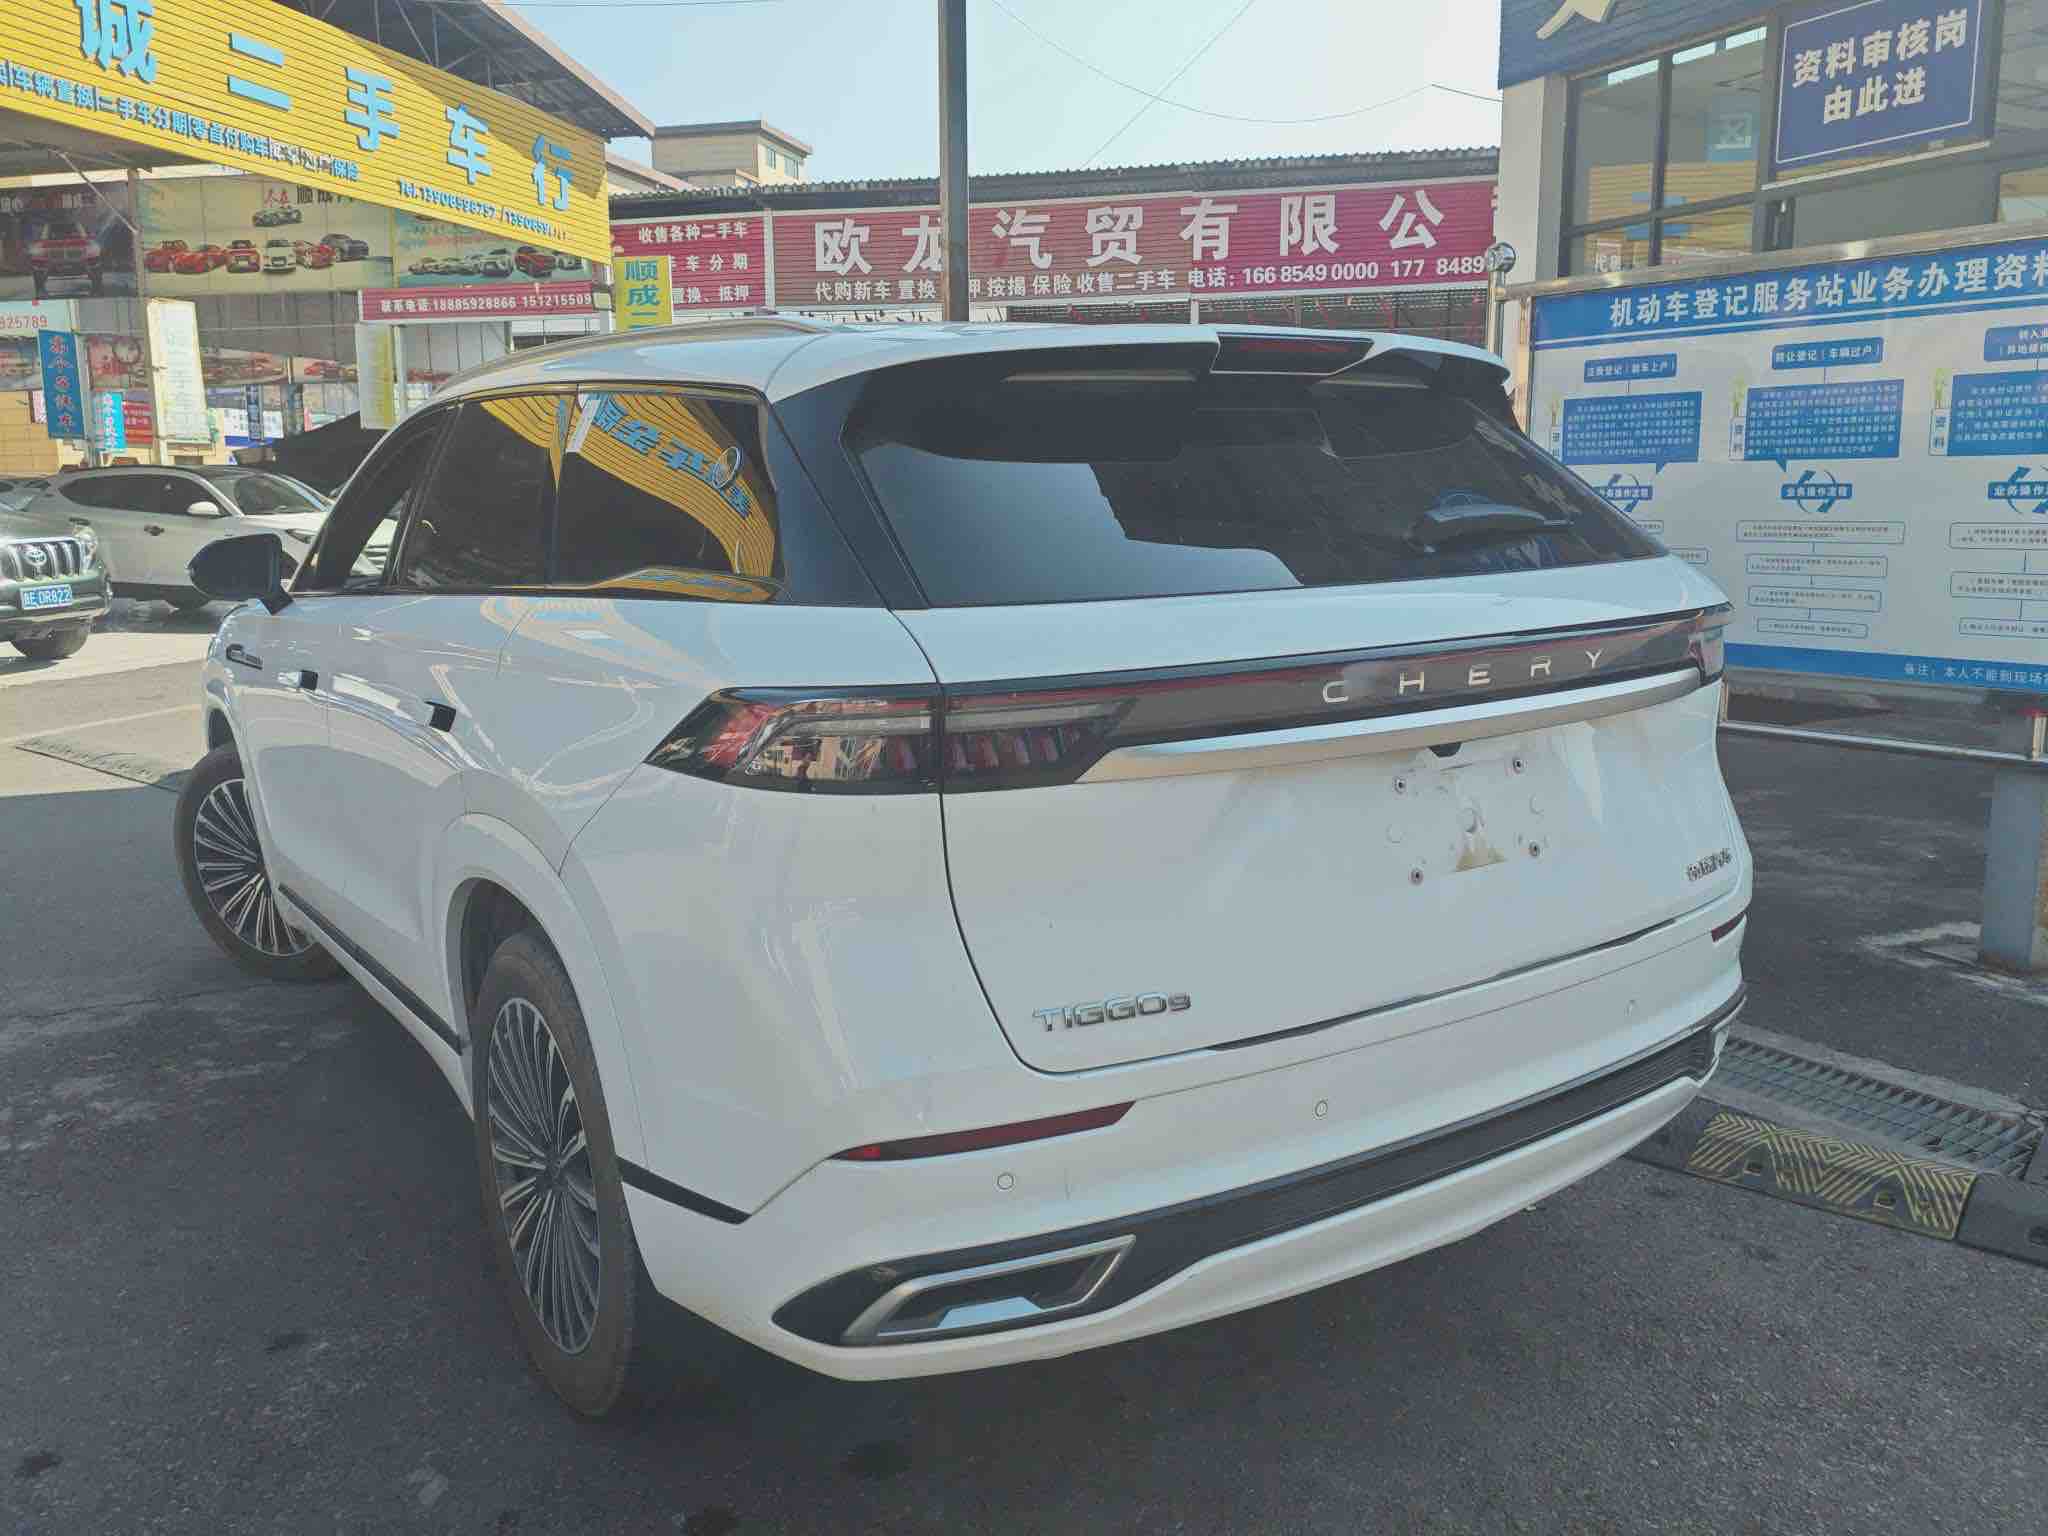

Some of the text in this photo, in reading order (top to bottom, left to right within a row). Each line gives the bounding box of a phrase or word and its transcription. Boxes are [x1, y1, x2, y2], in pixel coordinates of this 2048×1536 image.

[1792, 8, 1968, 89] 资料审核岗
[1823, 65, 1927, 124] 由此进
[815, 190, 1497, 276] 欧龙汽贸有限公
[815, 280, 892, 301] 代购新车
[898, 278, 937, 299] 置换
[1032, 274, 1072, 296] 保险
[1077, 269, 1176, 294] 收售二手车
[1243, 265, 1276, 284] 166
[1281, 263, 1327, 284] 8549
[1331, 262, 1379, 281] 0000
[1391, 259, 1425, 278] 177
[1436, 256, 1485, 276] 8489
[1322, 649, 1608, 704] CHERY
